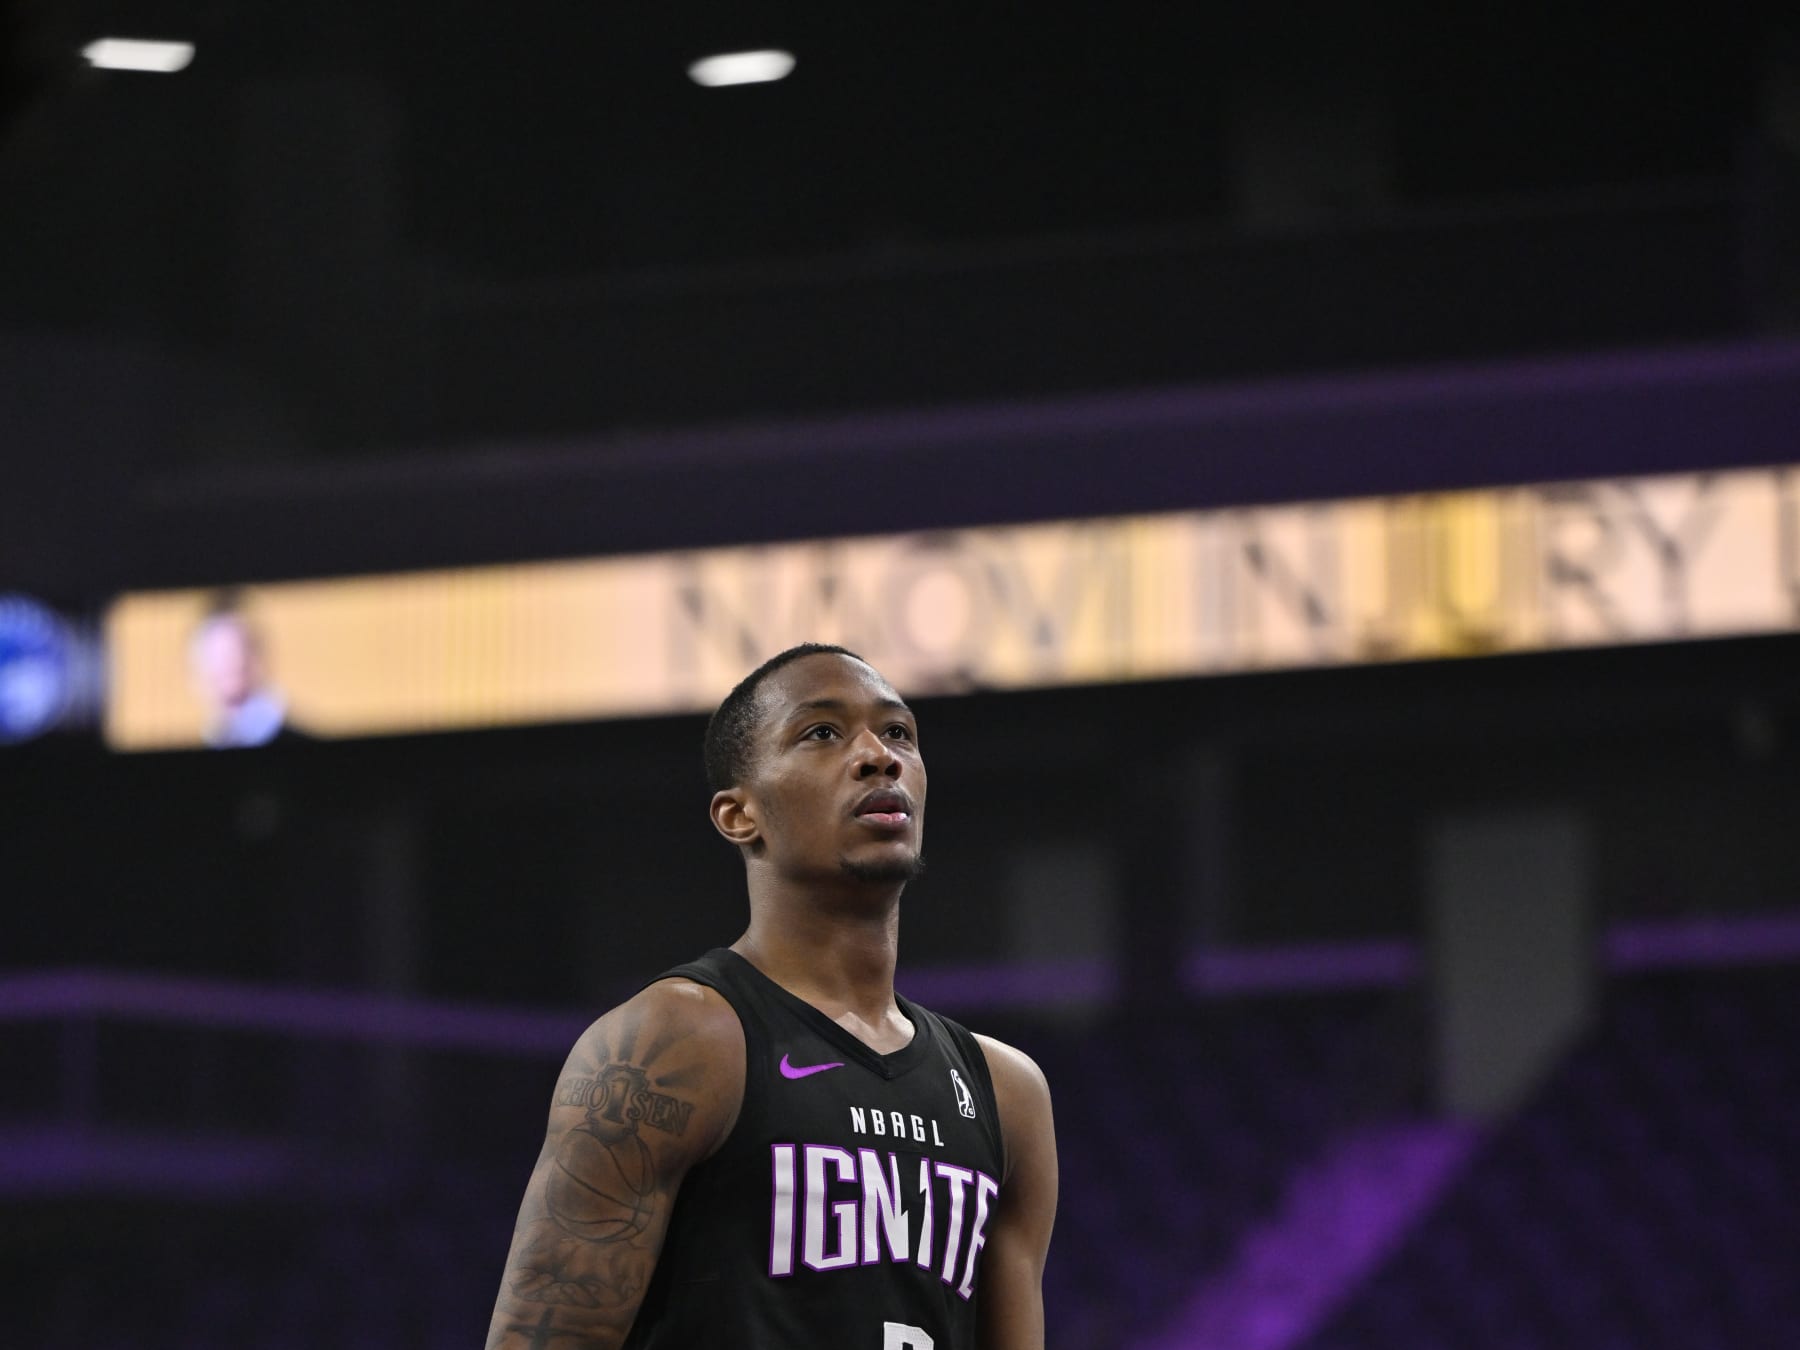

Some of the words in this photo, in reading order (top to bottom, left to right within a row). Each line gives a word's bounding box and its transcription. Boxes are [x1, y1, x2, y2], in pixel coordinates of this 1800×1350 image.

[1195, 474, 1735, 672] INJURY
[850, 1106, 945, 1147] NBAGL
[769, 1143, 999, 1301] IGNITE
